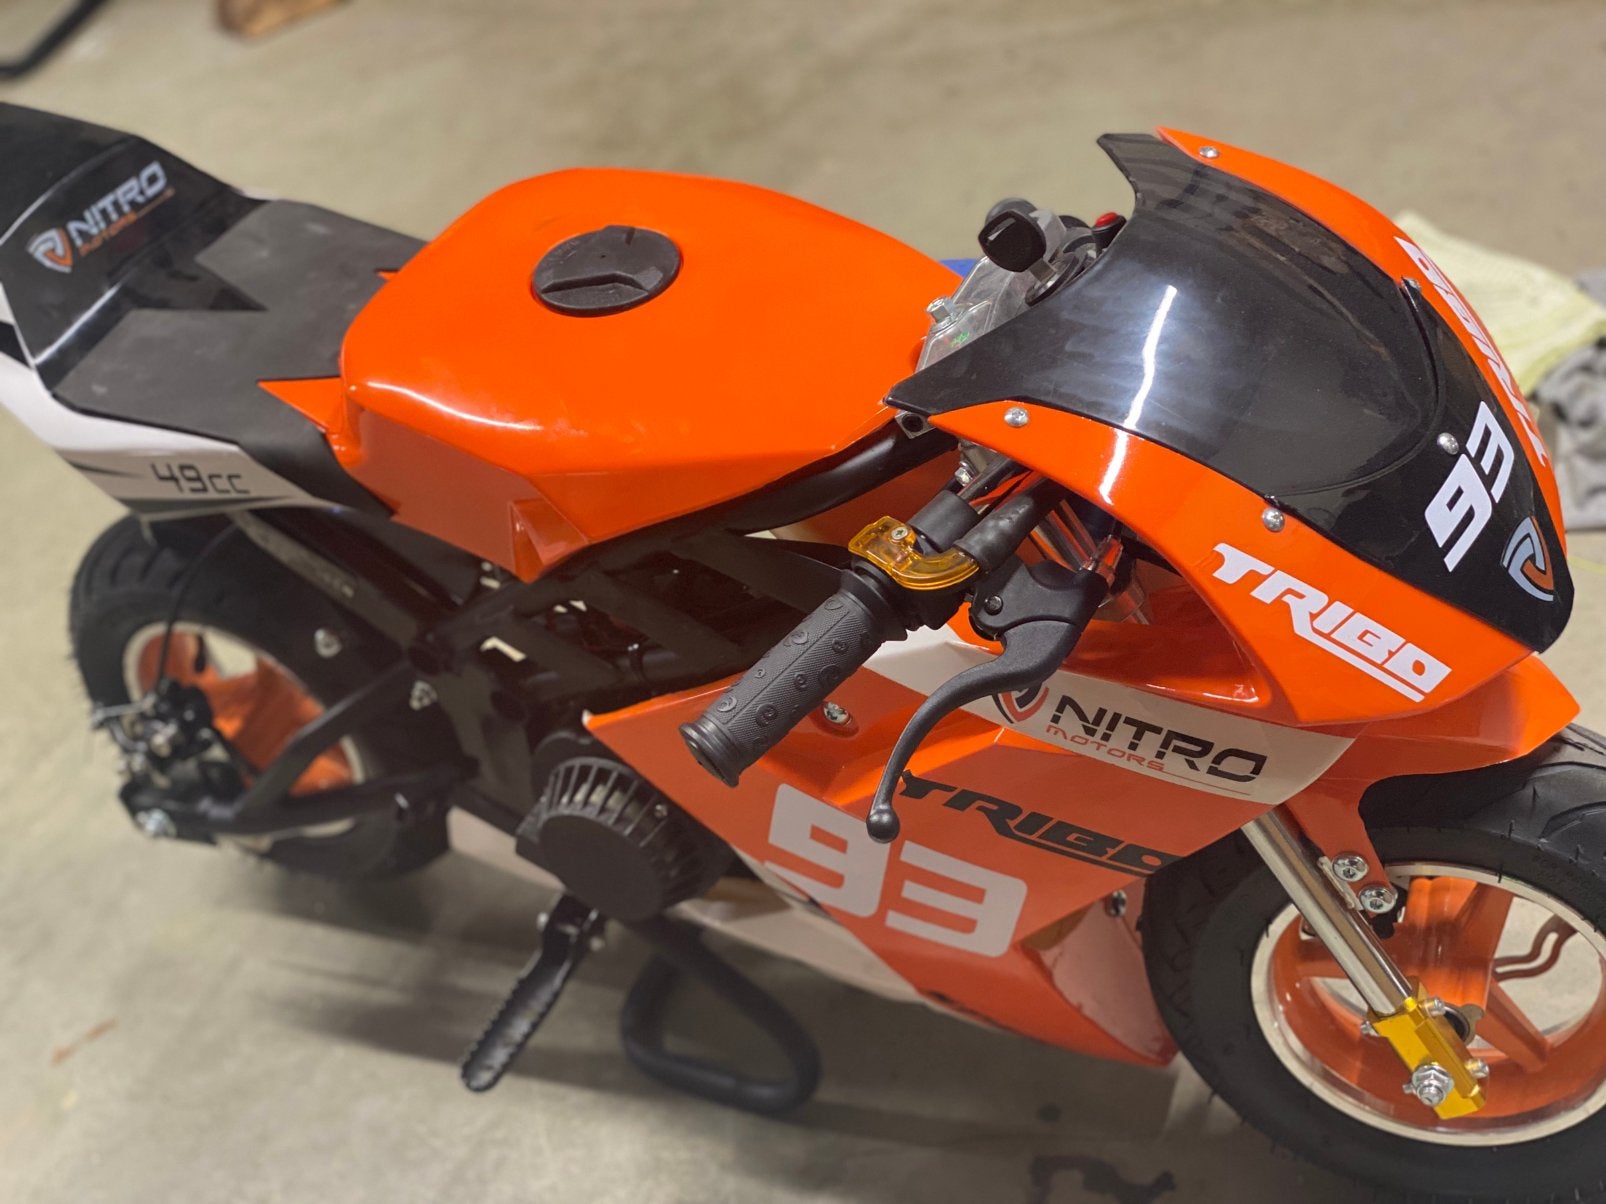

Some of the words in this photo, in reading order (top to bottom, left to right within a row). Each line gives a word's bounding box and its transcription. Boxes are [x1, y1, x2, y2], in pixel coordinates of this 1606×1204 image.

[66, 160, 167, 248] NITRO
[150, 463, 251, 494] 49cc
[1425, 401, 1515, 572] 93
[1212, 542, 1452, 702] TRIBO
[1046, 725, 1165, 772] MOTORS
[1050, 695, 1267, 783] NITRO
[762, 783, 1028, 958] 93
[899, 769, 1186, 879] TRIBO
